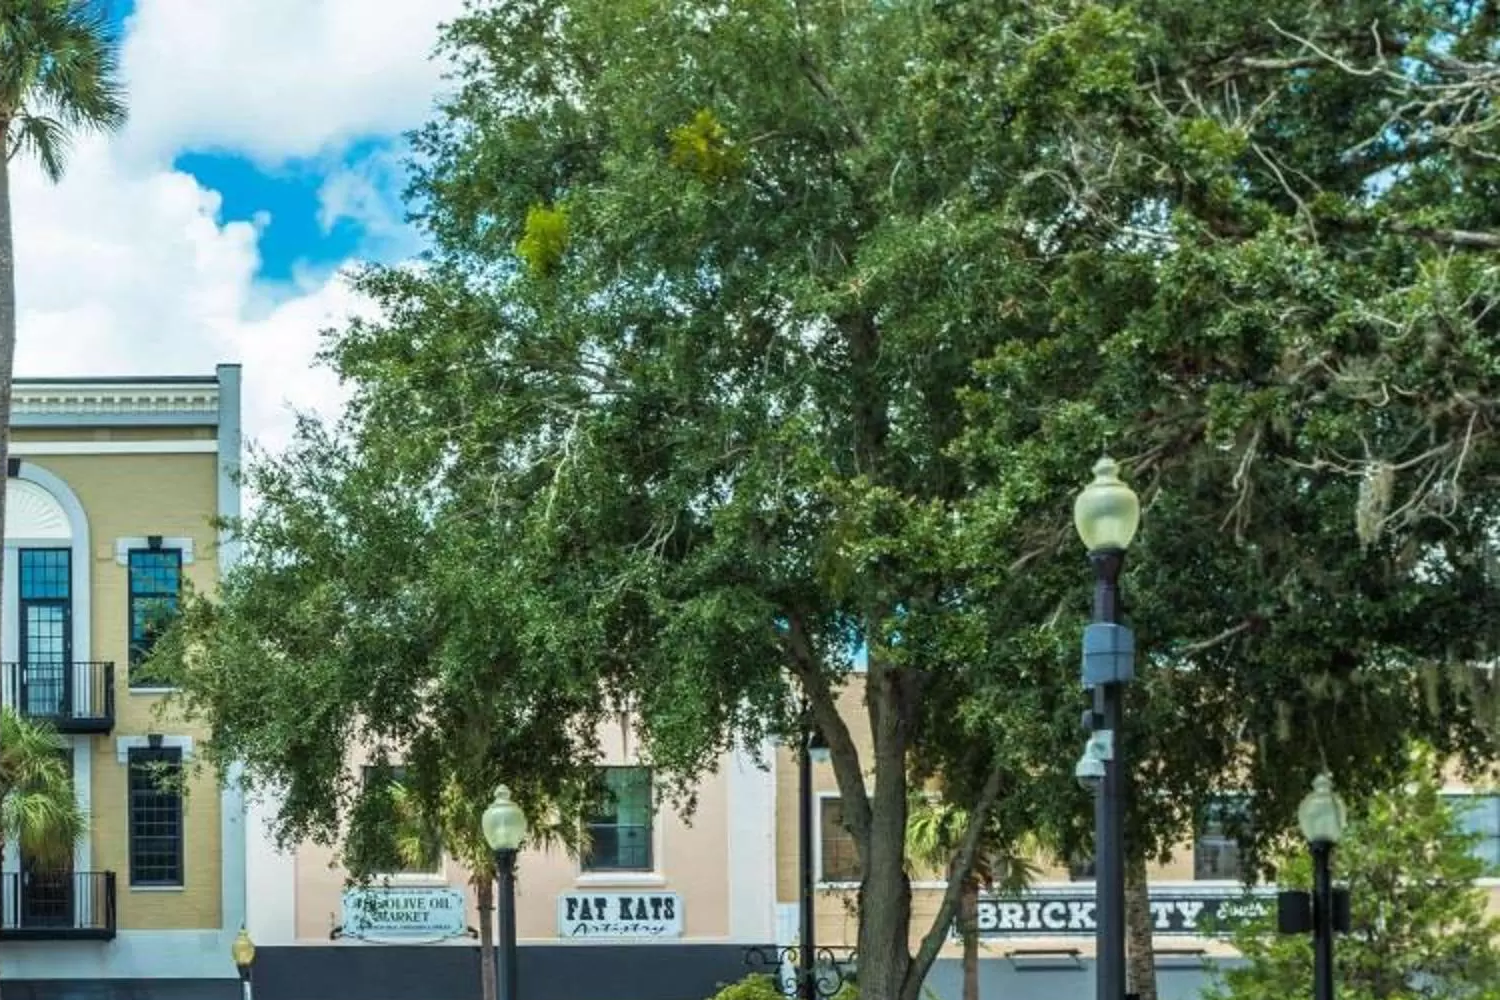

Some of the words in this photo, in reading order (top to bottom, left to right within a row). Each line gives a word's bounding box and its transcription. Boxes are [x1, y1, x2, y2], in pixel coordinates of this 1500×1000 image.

[429, 897, 453, 910] OIL
[565, 896, 607, 921] FAT
[618, 896, 675, 921] KATS
[977, 901, 1097, 930] BRICK
[1150, 901, 1204, 929] TY
